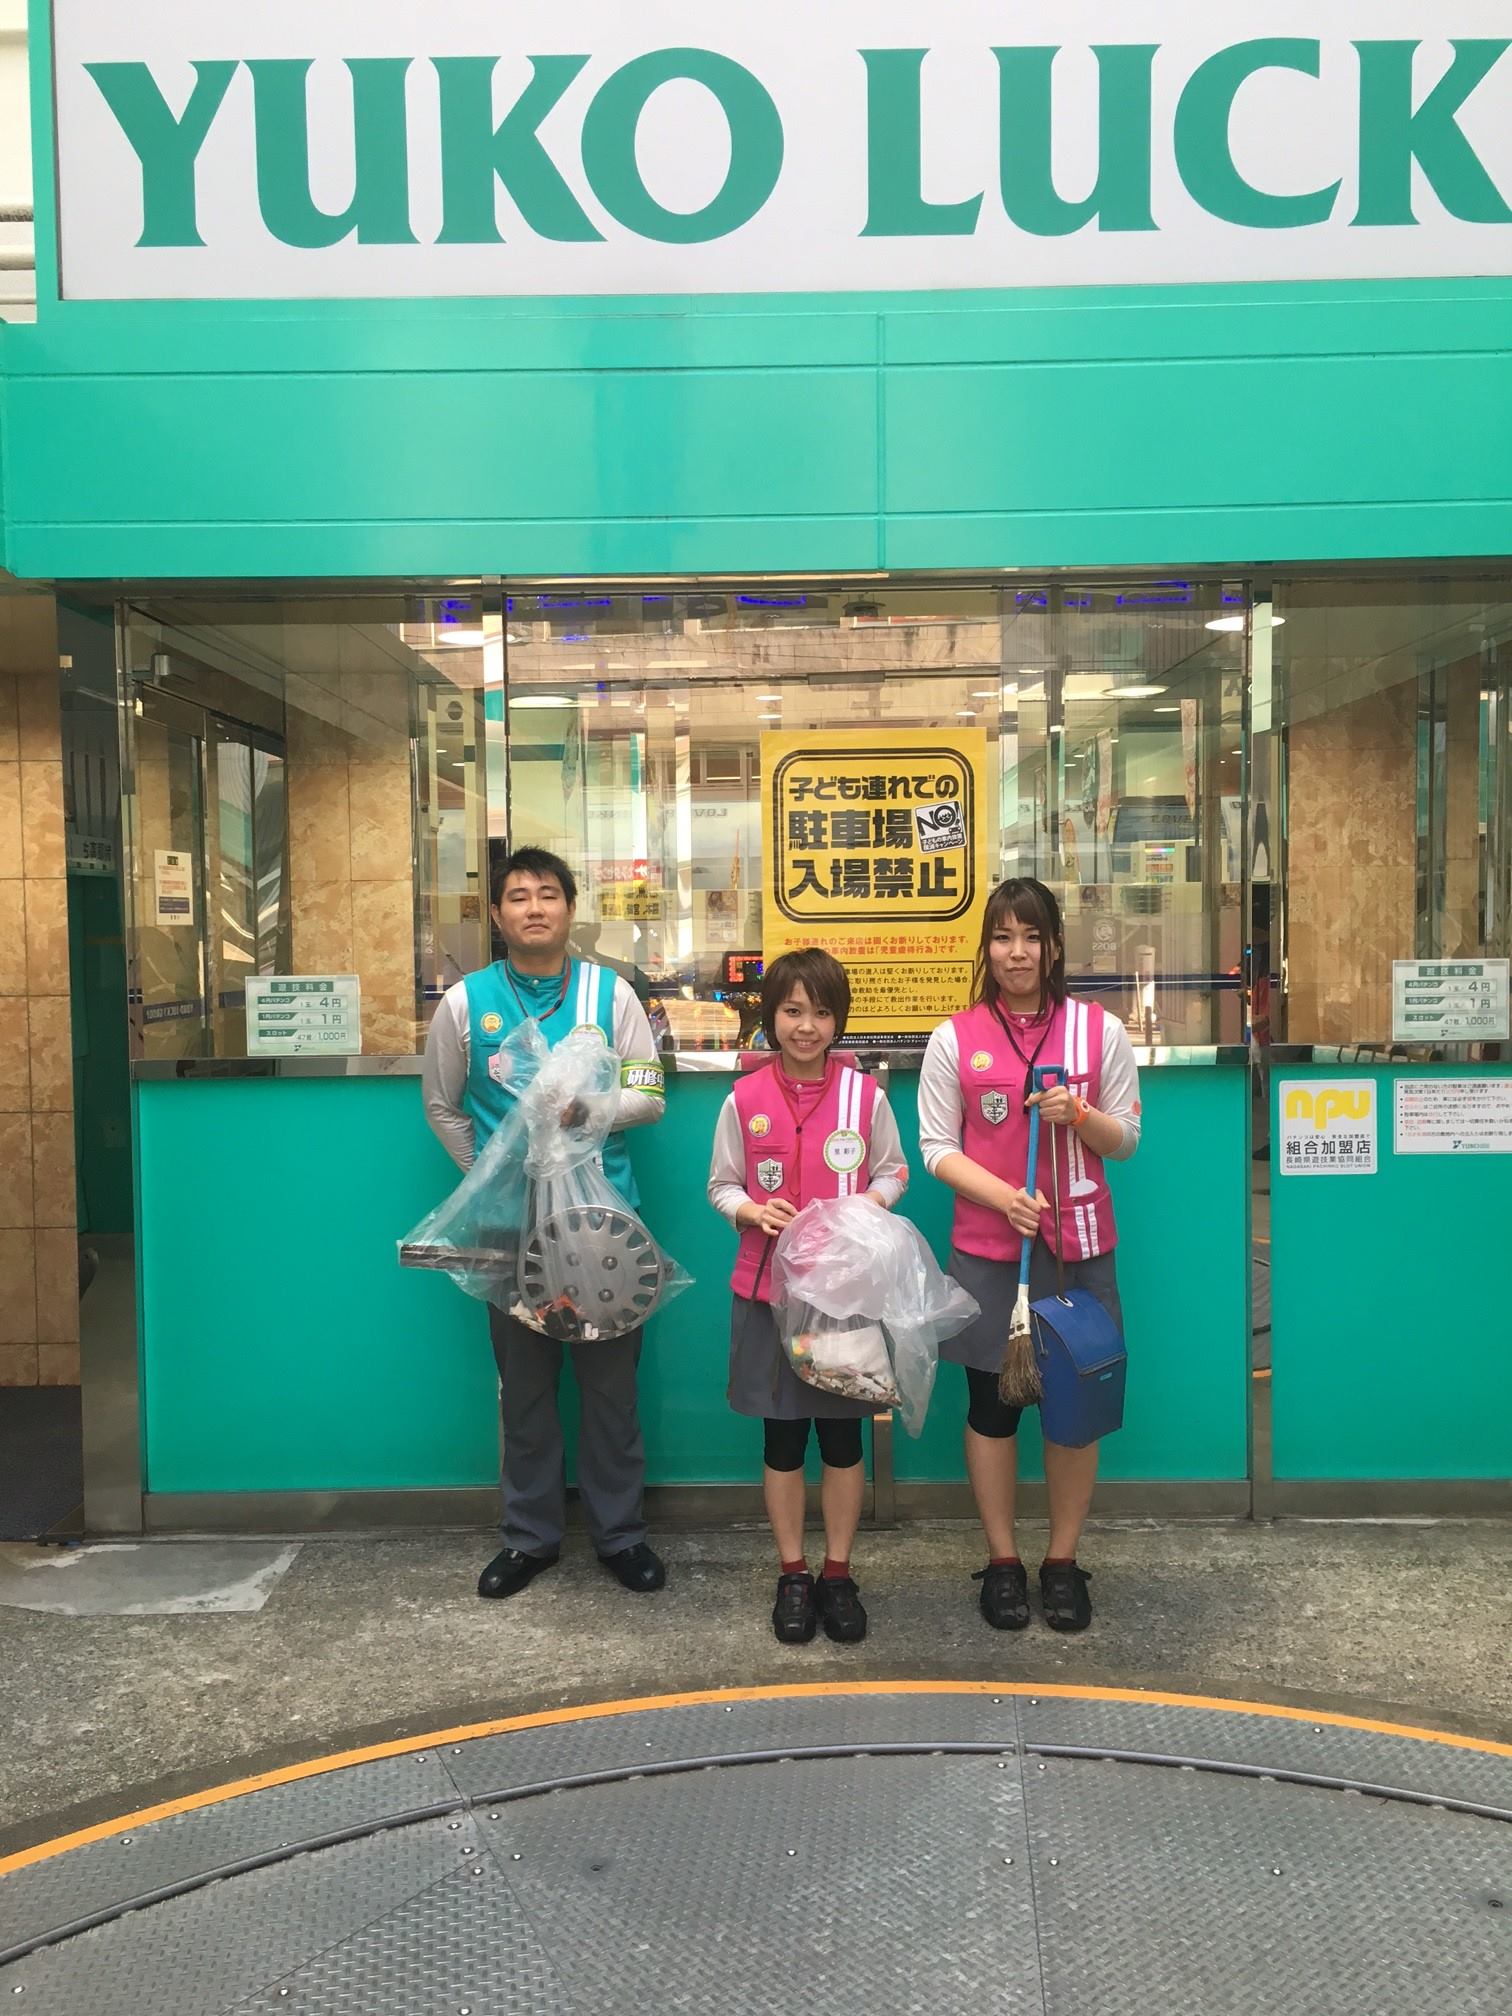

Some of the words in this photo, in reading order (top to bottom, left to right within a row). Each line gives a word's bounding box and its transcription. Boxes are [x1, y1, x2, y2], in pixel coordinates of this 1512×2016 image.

[83, 47, 784, 249] YUKO
[856, 37, 1512, 237] LUCK
[788, 774, 959, 802] 子ども連れでの
[788, 808, 913, 850] 駐車場
[788, 856, 957, 899] 入場禁止
[626, 1069, 665, 1089] 研修中
[1285, 1088, 1371, 1131] npu
[1286, 1140, 1371, 1155] 組合加盟店
